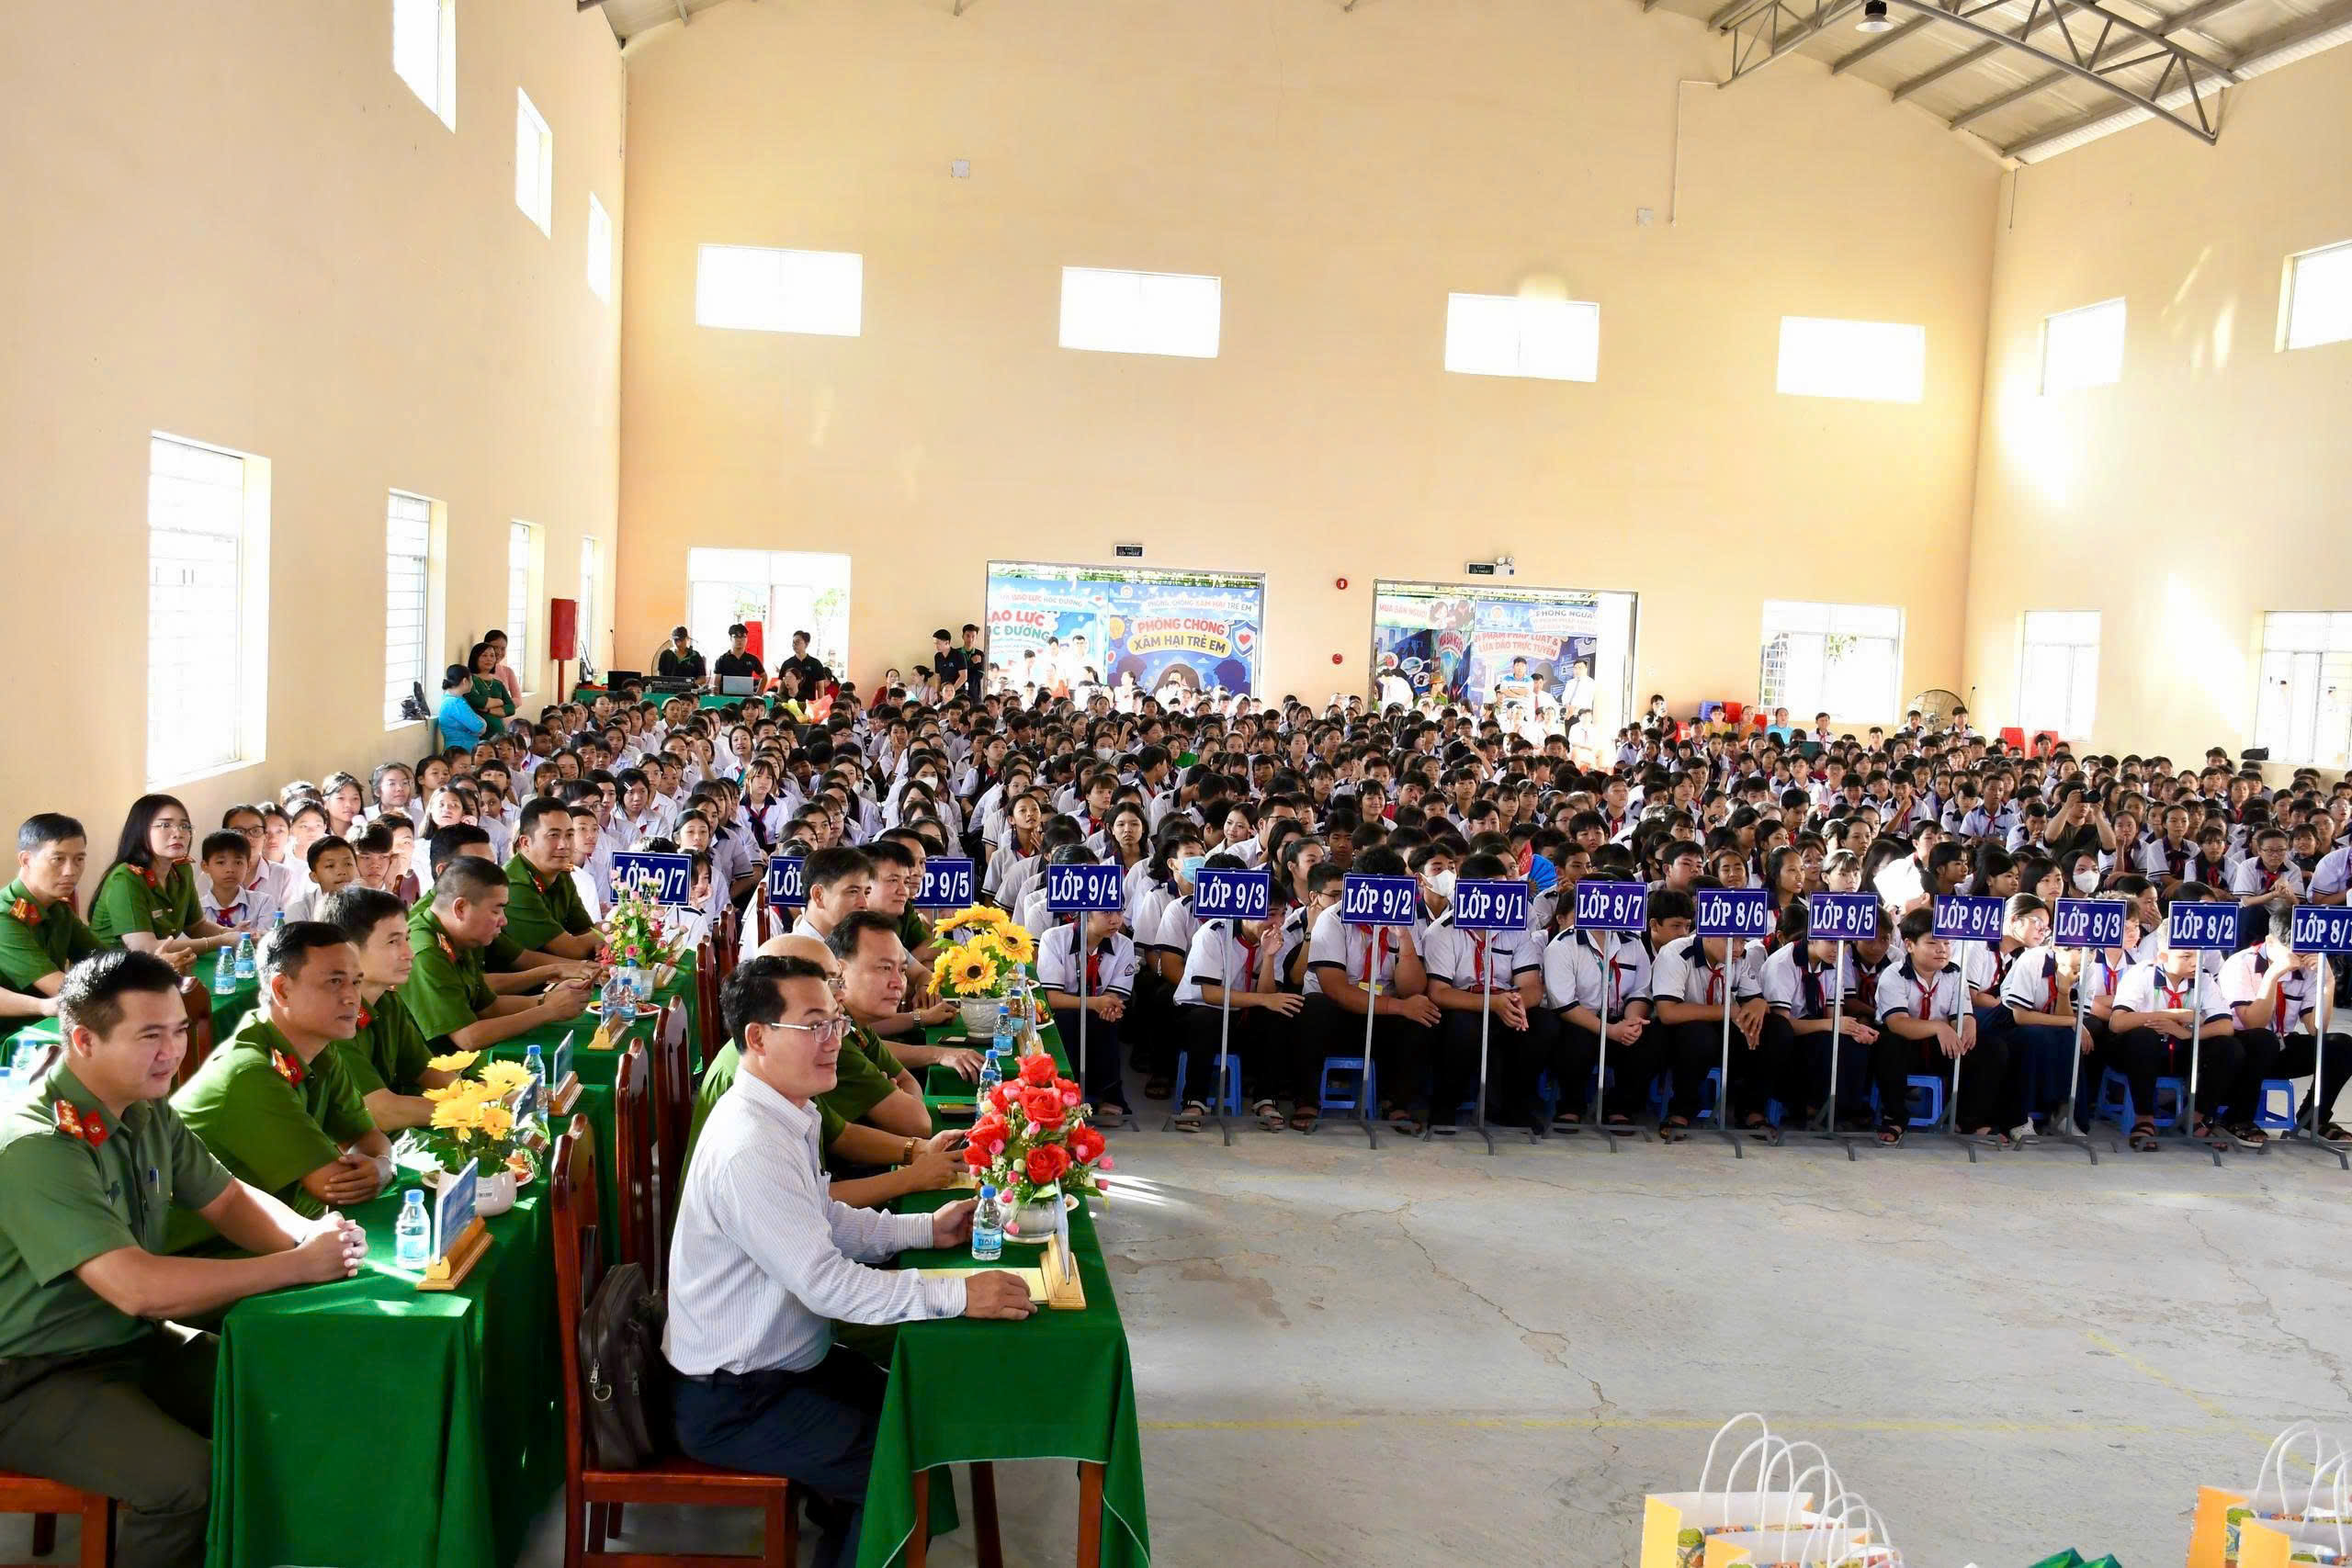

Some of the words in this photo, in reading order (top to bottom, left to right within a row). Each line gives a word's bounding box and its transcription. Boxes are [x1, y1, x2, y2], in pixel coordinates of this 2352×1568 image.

[988, 610, 1012, 624] ẠO
[1137, 616, 1181, 633] PHÒNG
[1183, 616, 1226, 636] CHỐNG
[1240, 604, 1252, 612] EM
[1004, 623, 1050, 642] ĐƯỜNG
[1134, 633, 1161, 650] XÂM
[1164, 634, 1184, 649] HẠI
[1187, 633, 1207, 649] TRẺ
[1209, 639, 1227, 653] EM
[1552, 637, 1559, 647] &
[655, 868, 685, 898] 9/7
[940, 871, 969, 902] 9/5
[1051, 868, 1083, 901] LỚP
[1089, 874, 1118, 906] 9/4
[1199, 875, 1231, 908] LỚP
[1237, 883, 1265, 914] 9/3
[1346, 881, 1378, 914] LỚP
[1384, 888, 1411, 919] 9/2
[1458, 886, 1490, 919] LỚP
[1496, 894, 1523, 925] 9/1
[1578, 887, 1610, 919] LỚP
[1614, 894, 1642, 925] 8/7
[1701, 894, 1731, 927] LỚP
[1736, 901, 1763, 931] 8/6
[1812, 897, 1842, 930] LỚP
[1847, 905, 1874, 935] 8/5
[1938, 897, 1969, 930] LỚP
[1973, 906, 2000, 935] 8/4
[2057, 905, 2089, 937] LỚP
[2093, 912, 2120, 942] 8/3
[2172, 908, 2202, 940] LỚP
[2207, 915, 2234, 944] 8/2
[2296, 912, 2326, 943] LỚP
